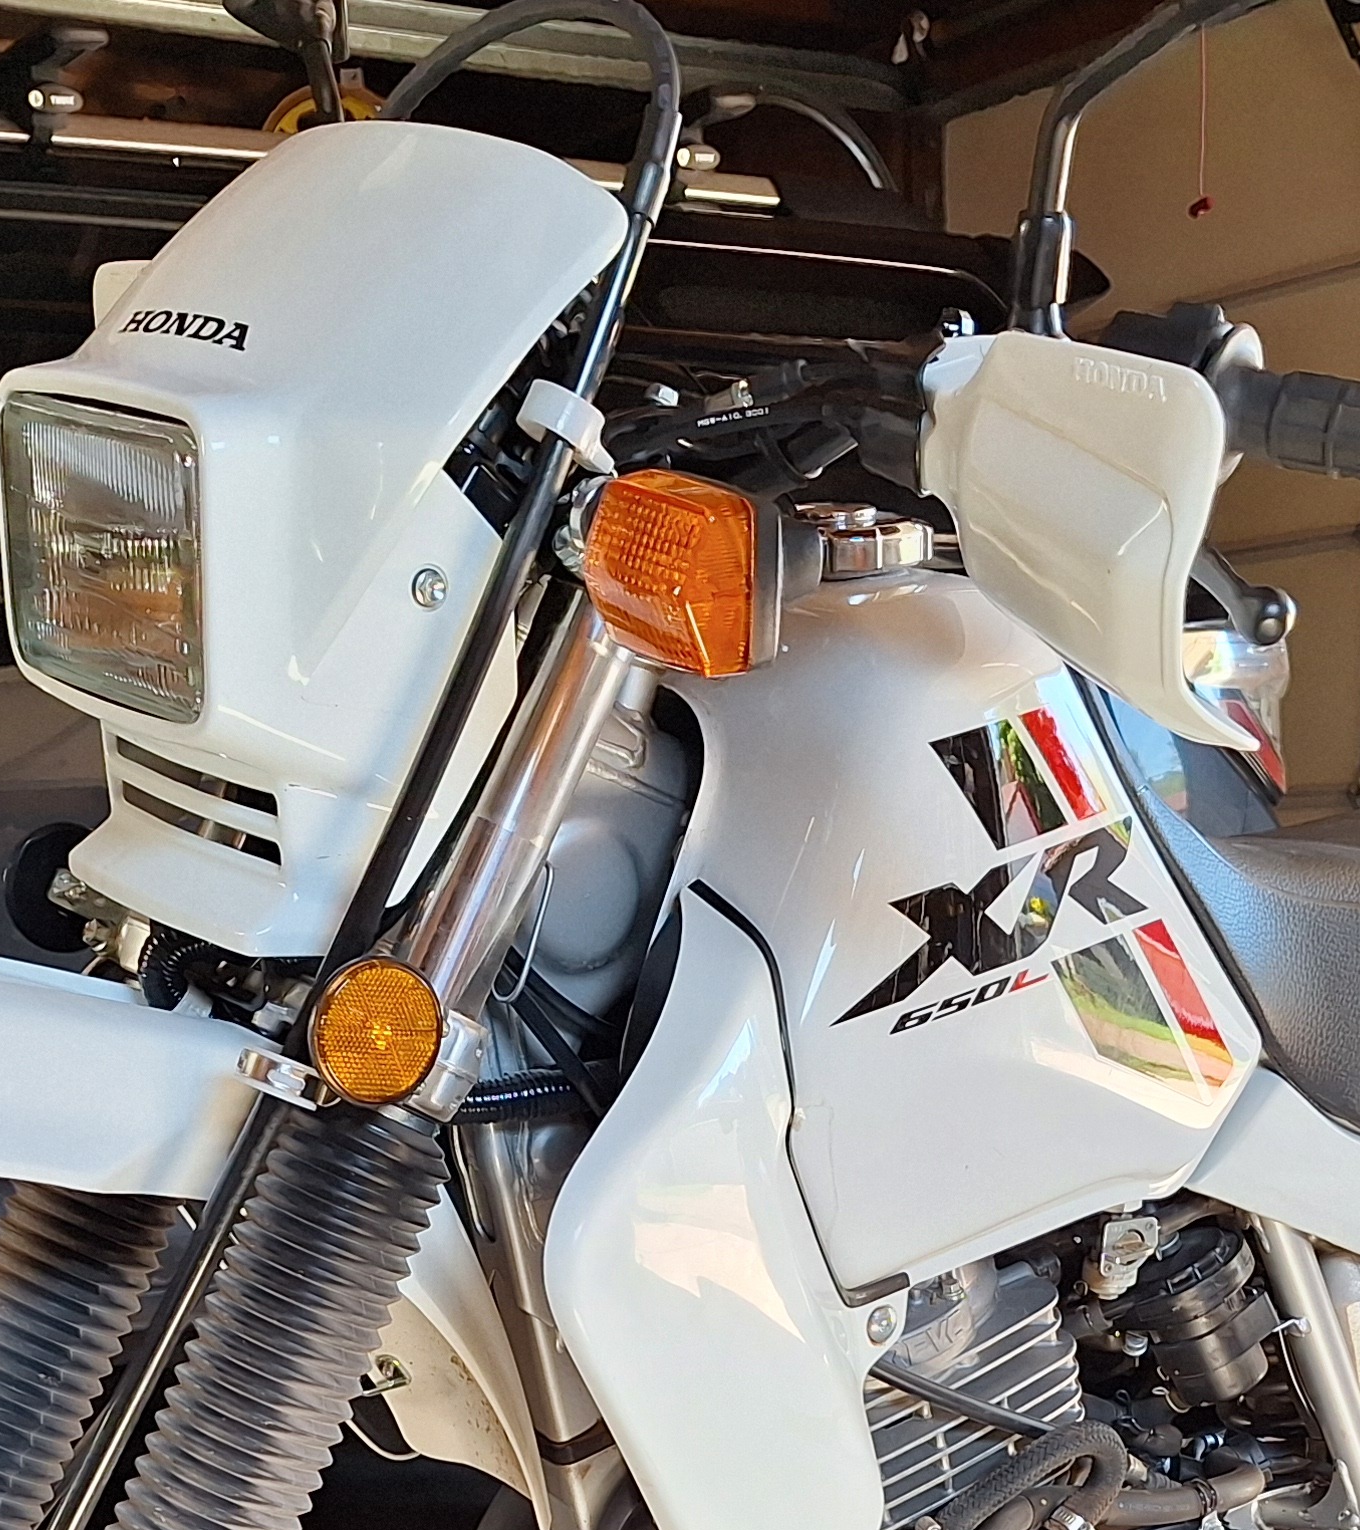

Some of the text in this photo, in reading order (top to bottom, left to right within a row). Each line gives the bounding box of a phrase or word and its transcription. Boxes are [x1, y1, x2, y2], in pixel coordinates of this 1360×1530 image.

[118, 310, 250, 352] HONDA
[1072, 356, 1168, 403] HONDA
[829, 816, 1149, 1027] XR
[889, 968, 1050, 1035] 650L
